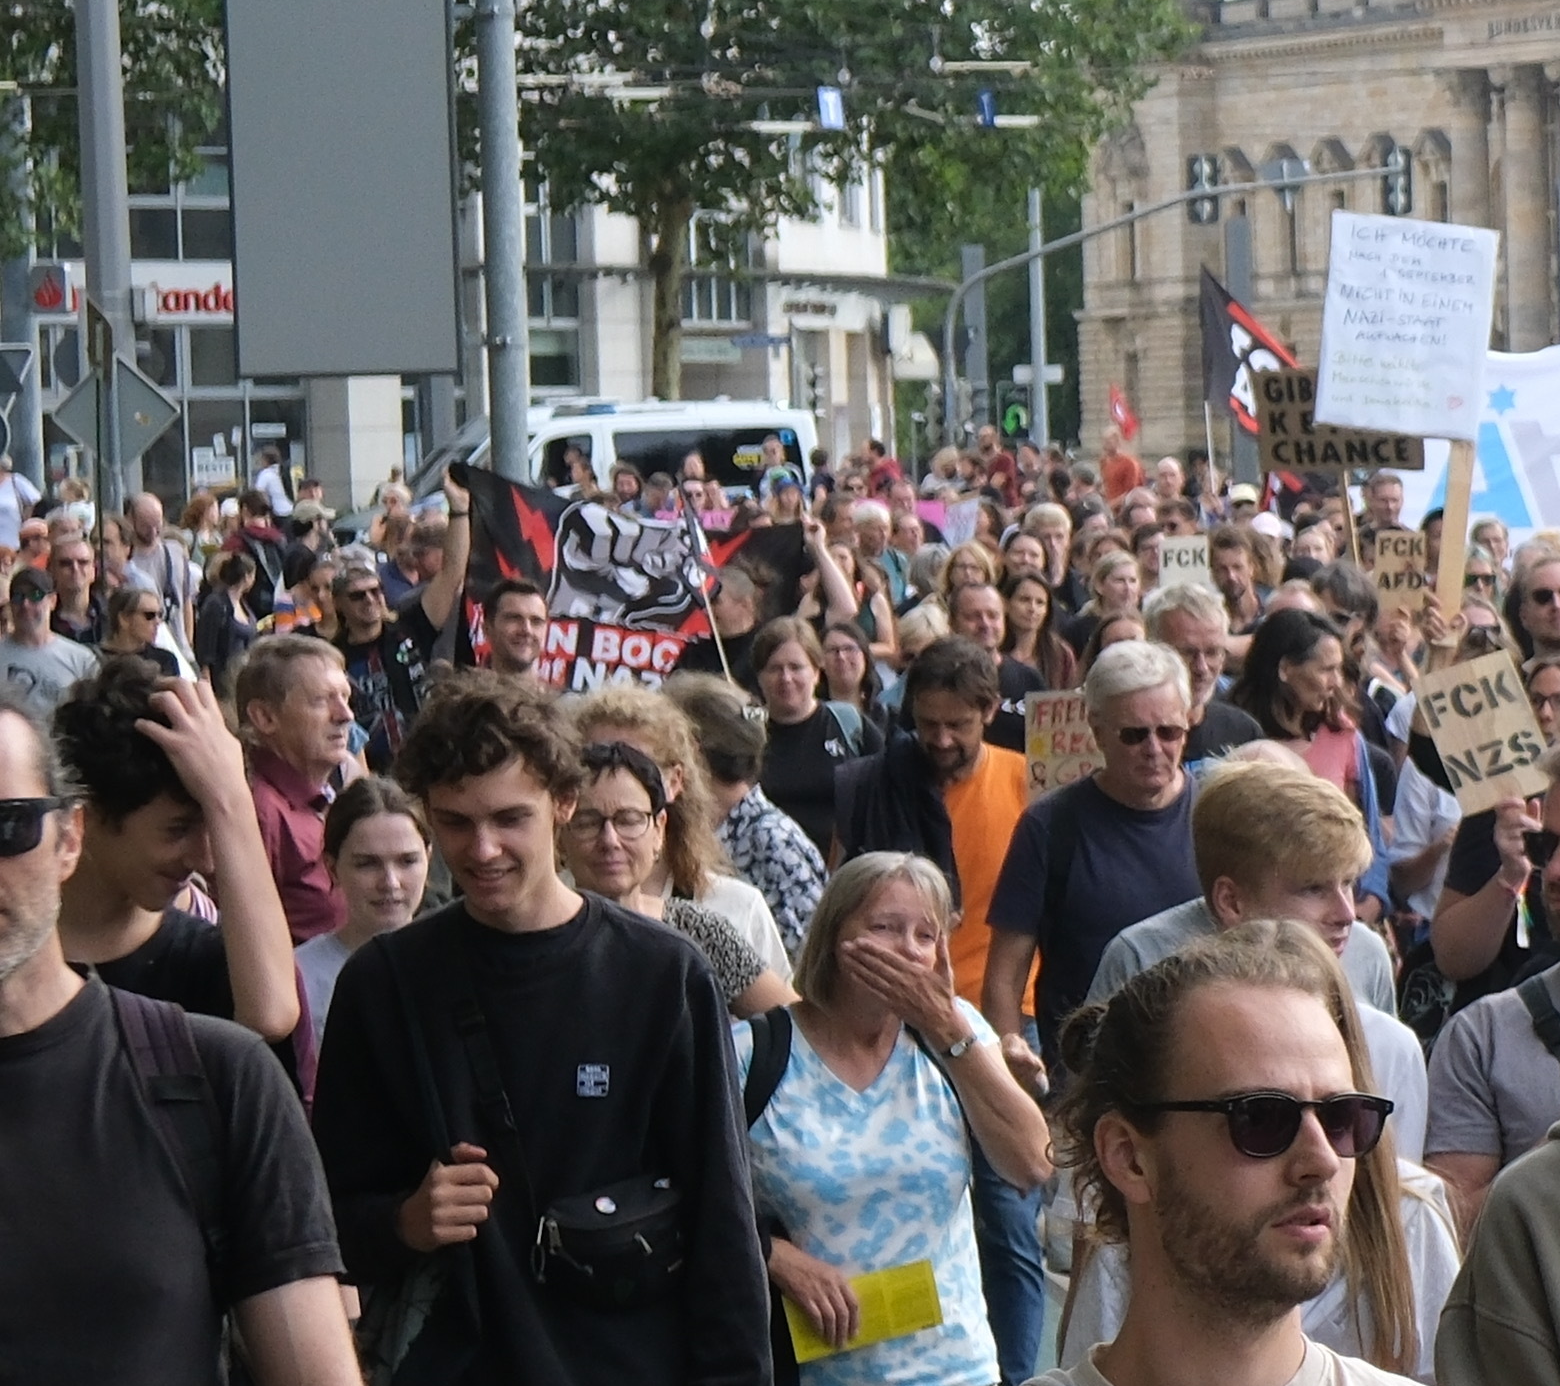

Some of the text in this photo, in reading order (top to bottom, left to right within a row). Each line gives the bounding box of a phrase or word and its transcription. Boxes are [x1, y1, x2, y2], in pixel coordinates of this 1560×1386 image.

[1350, 223, 1477, 254] ICH MÖCHTE
[1270, 436, 1410, 465] CHANCE
[1162, 546, 1207, 569] FCK
[1378, 537, 1425, 557] FCK
[1377, 570, 1423, 591] AFD
[591, 625, 681, 673] BOC
[1422, 670, 1518, 729] FCK
[1444, 730, 1542, 790] NZS
